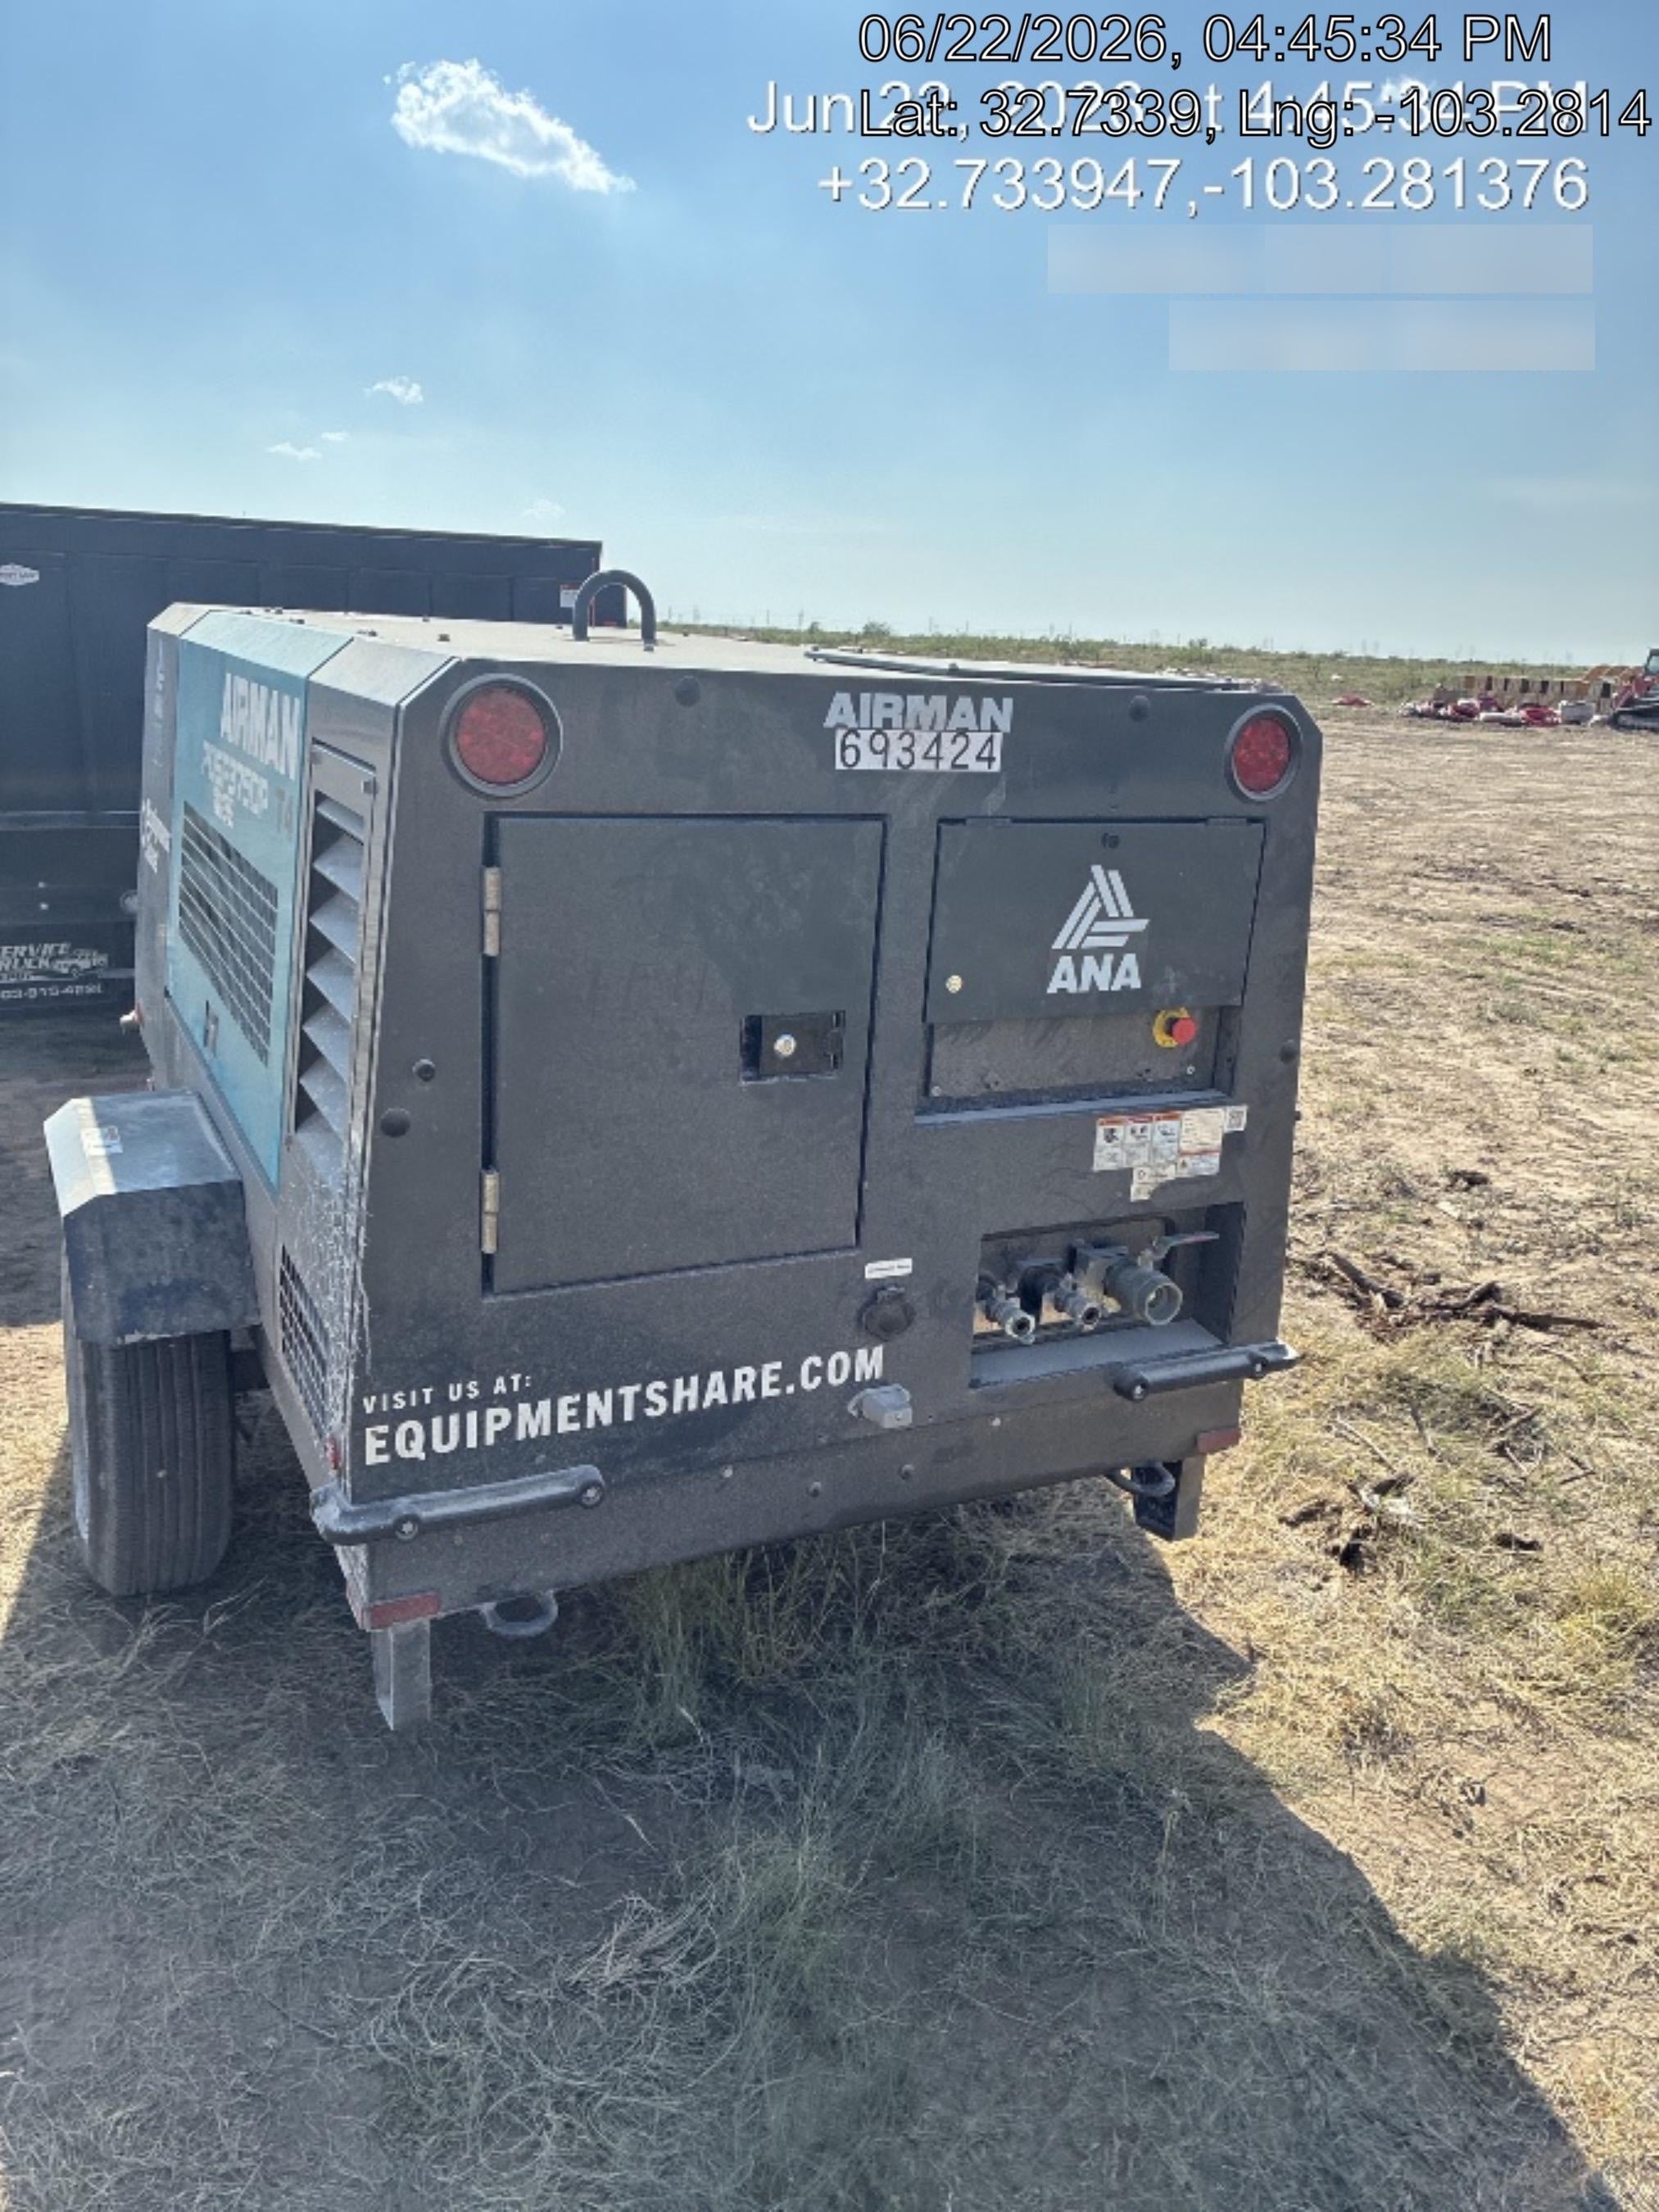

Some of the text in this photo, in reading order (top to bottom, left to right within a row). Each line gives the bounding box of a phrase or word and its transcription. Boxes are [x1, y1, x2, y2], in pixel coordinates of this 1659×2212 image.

[823, 691, 1013, 732] AIRMAN
[840, 728, 996, 770] 693424
[1046, 953, 1142, 994] ANA
[363, 1373, 532, 1414] VISIT US AT:
[365, 1344, 884, 1466] EQUIPMENTSHARE.COM
